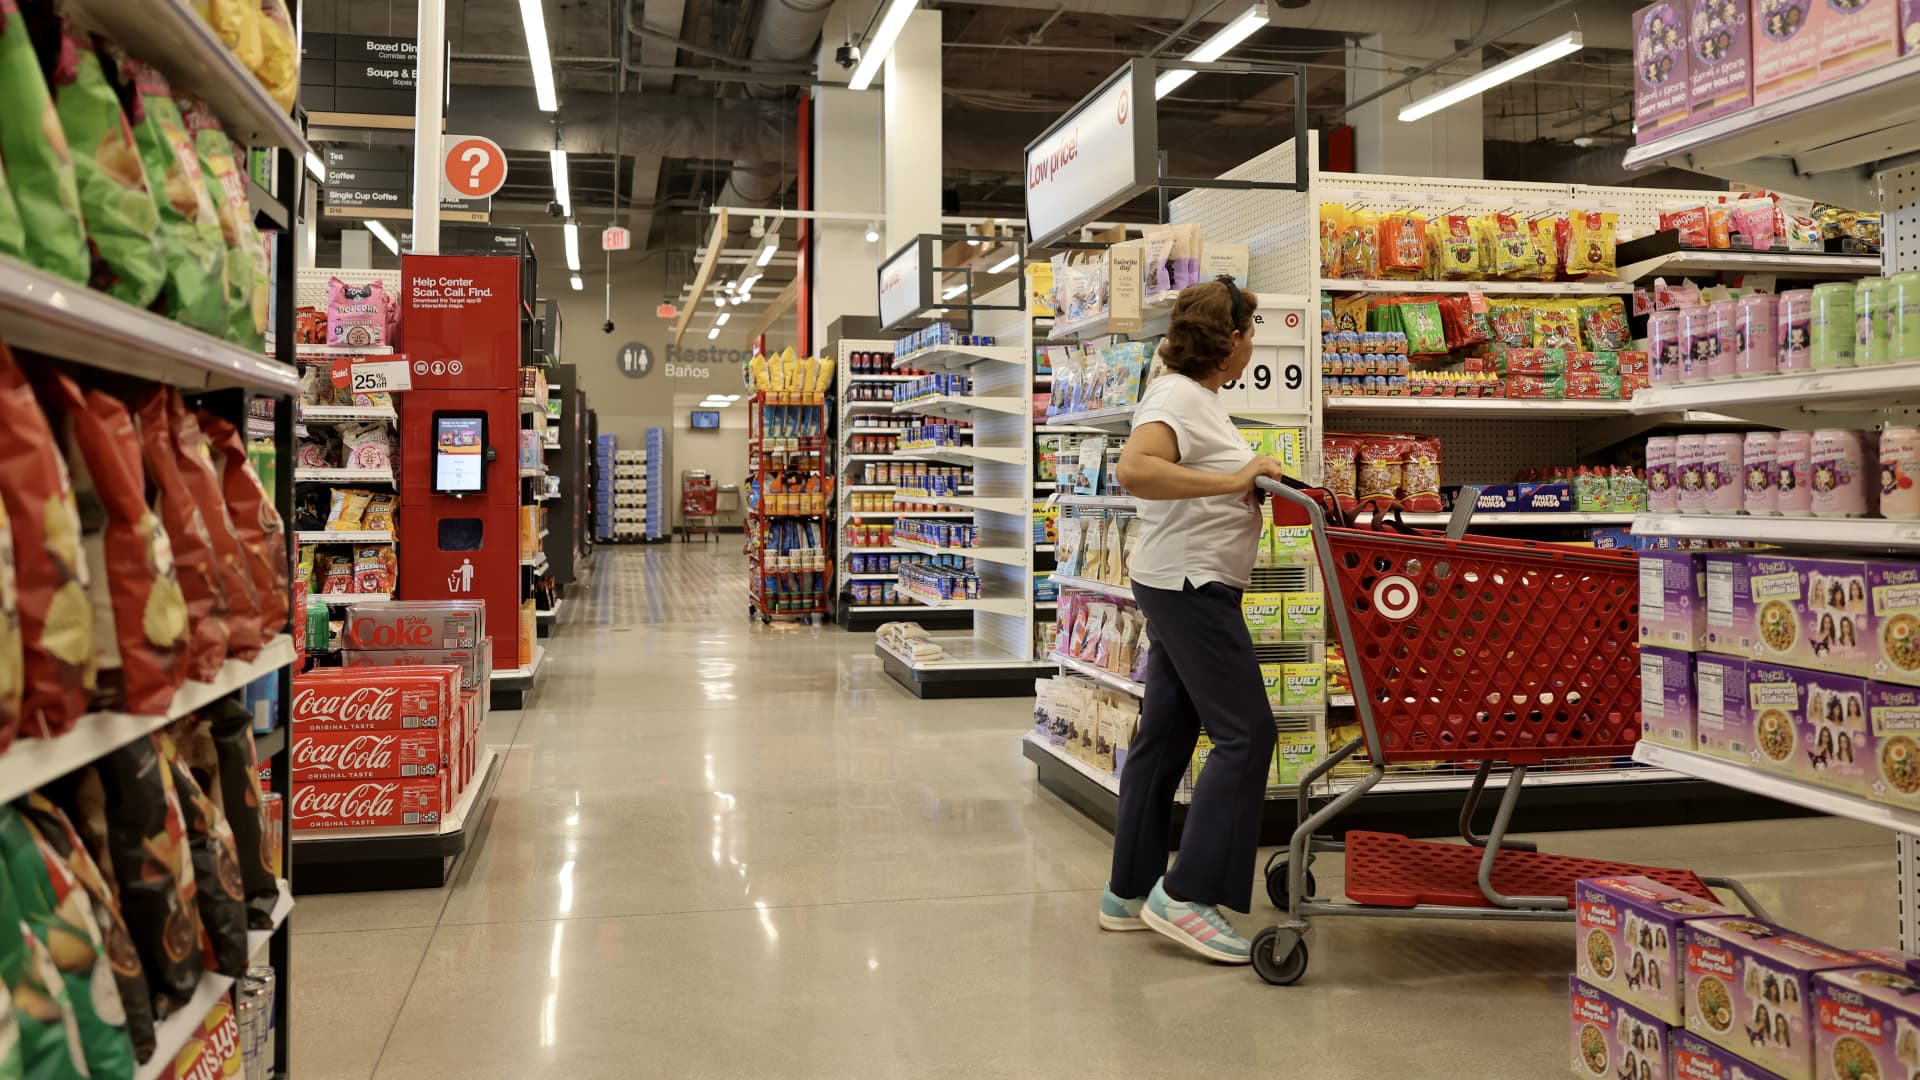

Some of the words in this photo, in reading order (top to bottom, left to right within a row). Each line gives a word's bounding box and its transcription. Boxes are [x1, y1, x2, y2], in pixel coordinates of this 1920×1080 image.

[366, 41, 398, 52] Boxed
[401, 43, 417, 53] Din
[366, 67, 399, 79] Soups
[401, 69, 409, 78] &
[329, 153, 343, 161] Tea
[1030, 157, 1048, 189] Low
[1051, 128, 1078, 182] price!
[460, 147, 490, 188] ?
[329, 171, 355, 180] Coffee
[329, 191, 354, 200] Single
[354, 192, 370, 201] Cup
[372, 192, 398, 200] Coffee
[606, 230, 625, 248] EXIT
[1113, 257, 1138, 265] favorite
[1119, 264, 1131, 272] day
[413, 277, 436, 288] Help
[439, 277, 473, 287] Center
[413, 288, 441, 297] Scan.
[444, 288, 465, 297] Call.
[469, 288, 492, 297] Find.
[338, 304, 378, 313] POPCORN
[1253, 314, 1265, 324] e.
[332, 367, 348, 379] Sale!
[665, 363, 710, 378] Baños
[376, 381, 387, 389] off
[1284, 432, 1294, 467] BUILT
[1531, 500, 1560, 508] PAYASO
[1278, 527, 1309, 538] BUILT
[1246, 605, 1279, 616] BUILT
[1287, 605, 1320, 615] BUILT
[404, 615, 427, 625] Diet
[352, 617, 433, 648] Coke
[403, 656, 425, 666] Diet
[1287, 676, 1320, 686] BUILT
[292, 687, 400, 723] Coca-Cola
[292, 735, 400, 771] Coca-Cola
[1282, 744, 1315, 754] BUILT
[292, 783, 400, 819] Coca-Cola
